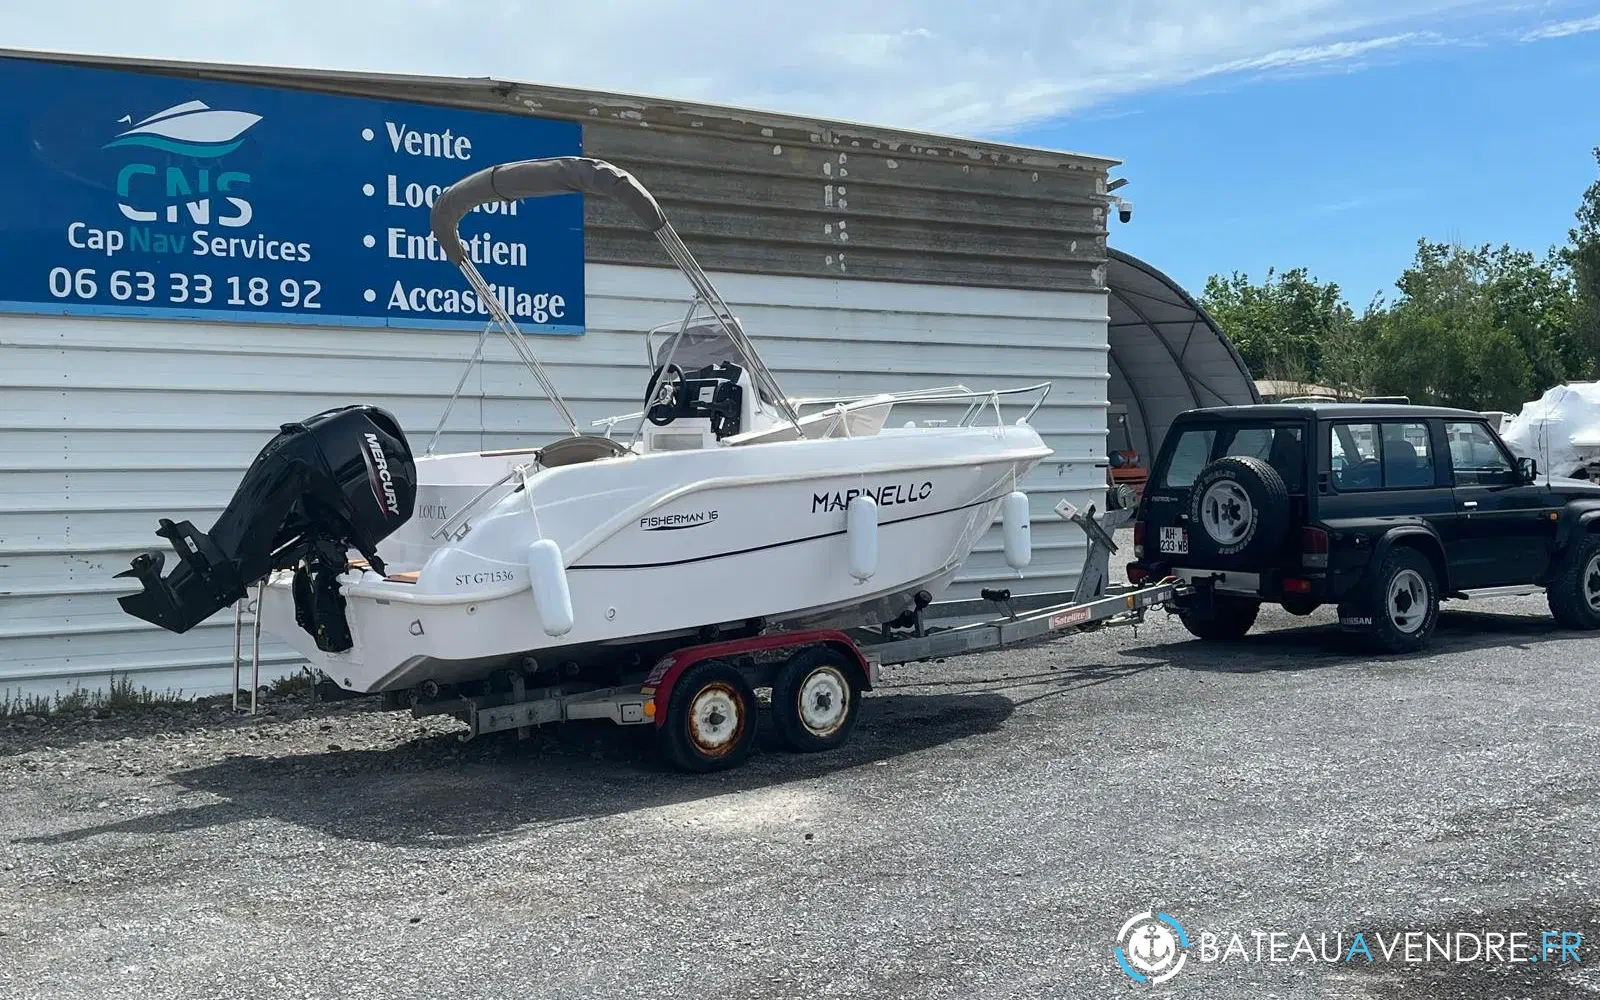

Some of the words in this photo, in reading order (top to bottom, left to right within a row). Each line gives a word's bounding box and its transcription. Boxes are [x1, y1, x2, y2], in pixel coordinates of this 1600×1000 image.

[385, 121, 472, 161] Vente
[117, 163, 253, 228] CNS
[67, 221, 124, 257] Cap
[129, 226, 186, 255] Nav
[192, 230, 311, 262] Services
[49, 266, 98, 299] 06
[109, 270, 156, 301] 63
[169, 272, 213, 304] 33
[226, 276, 269, 306] 18
[279, 278, 322, 309] 92
[364, 432, 400, 516] MERCURY
[640, 511, 704, 528] FISHERMAN
[708, 510, 719, 520] 16
[455, 574, 471, 586] ST
[473, 570, 514, 584] G71536
